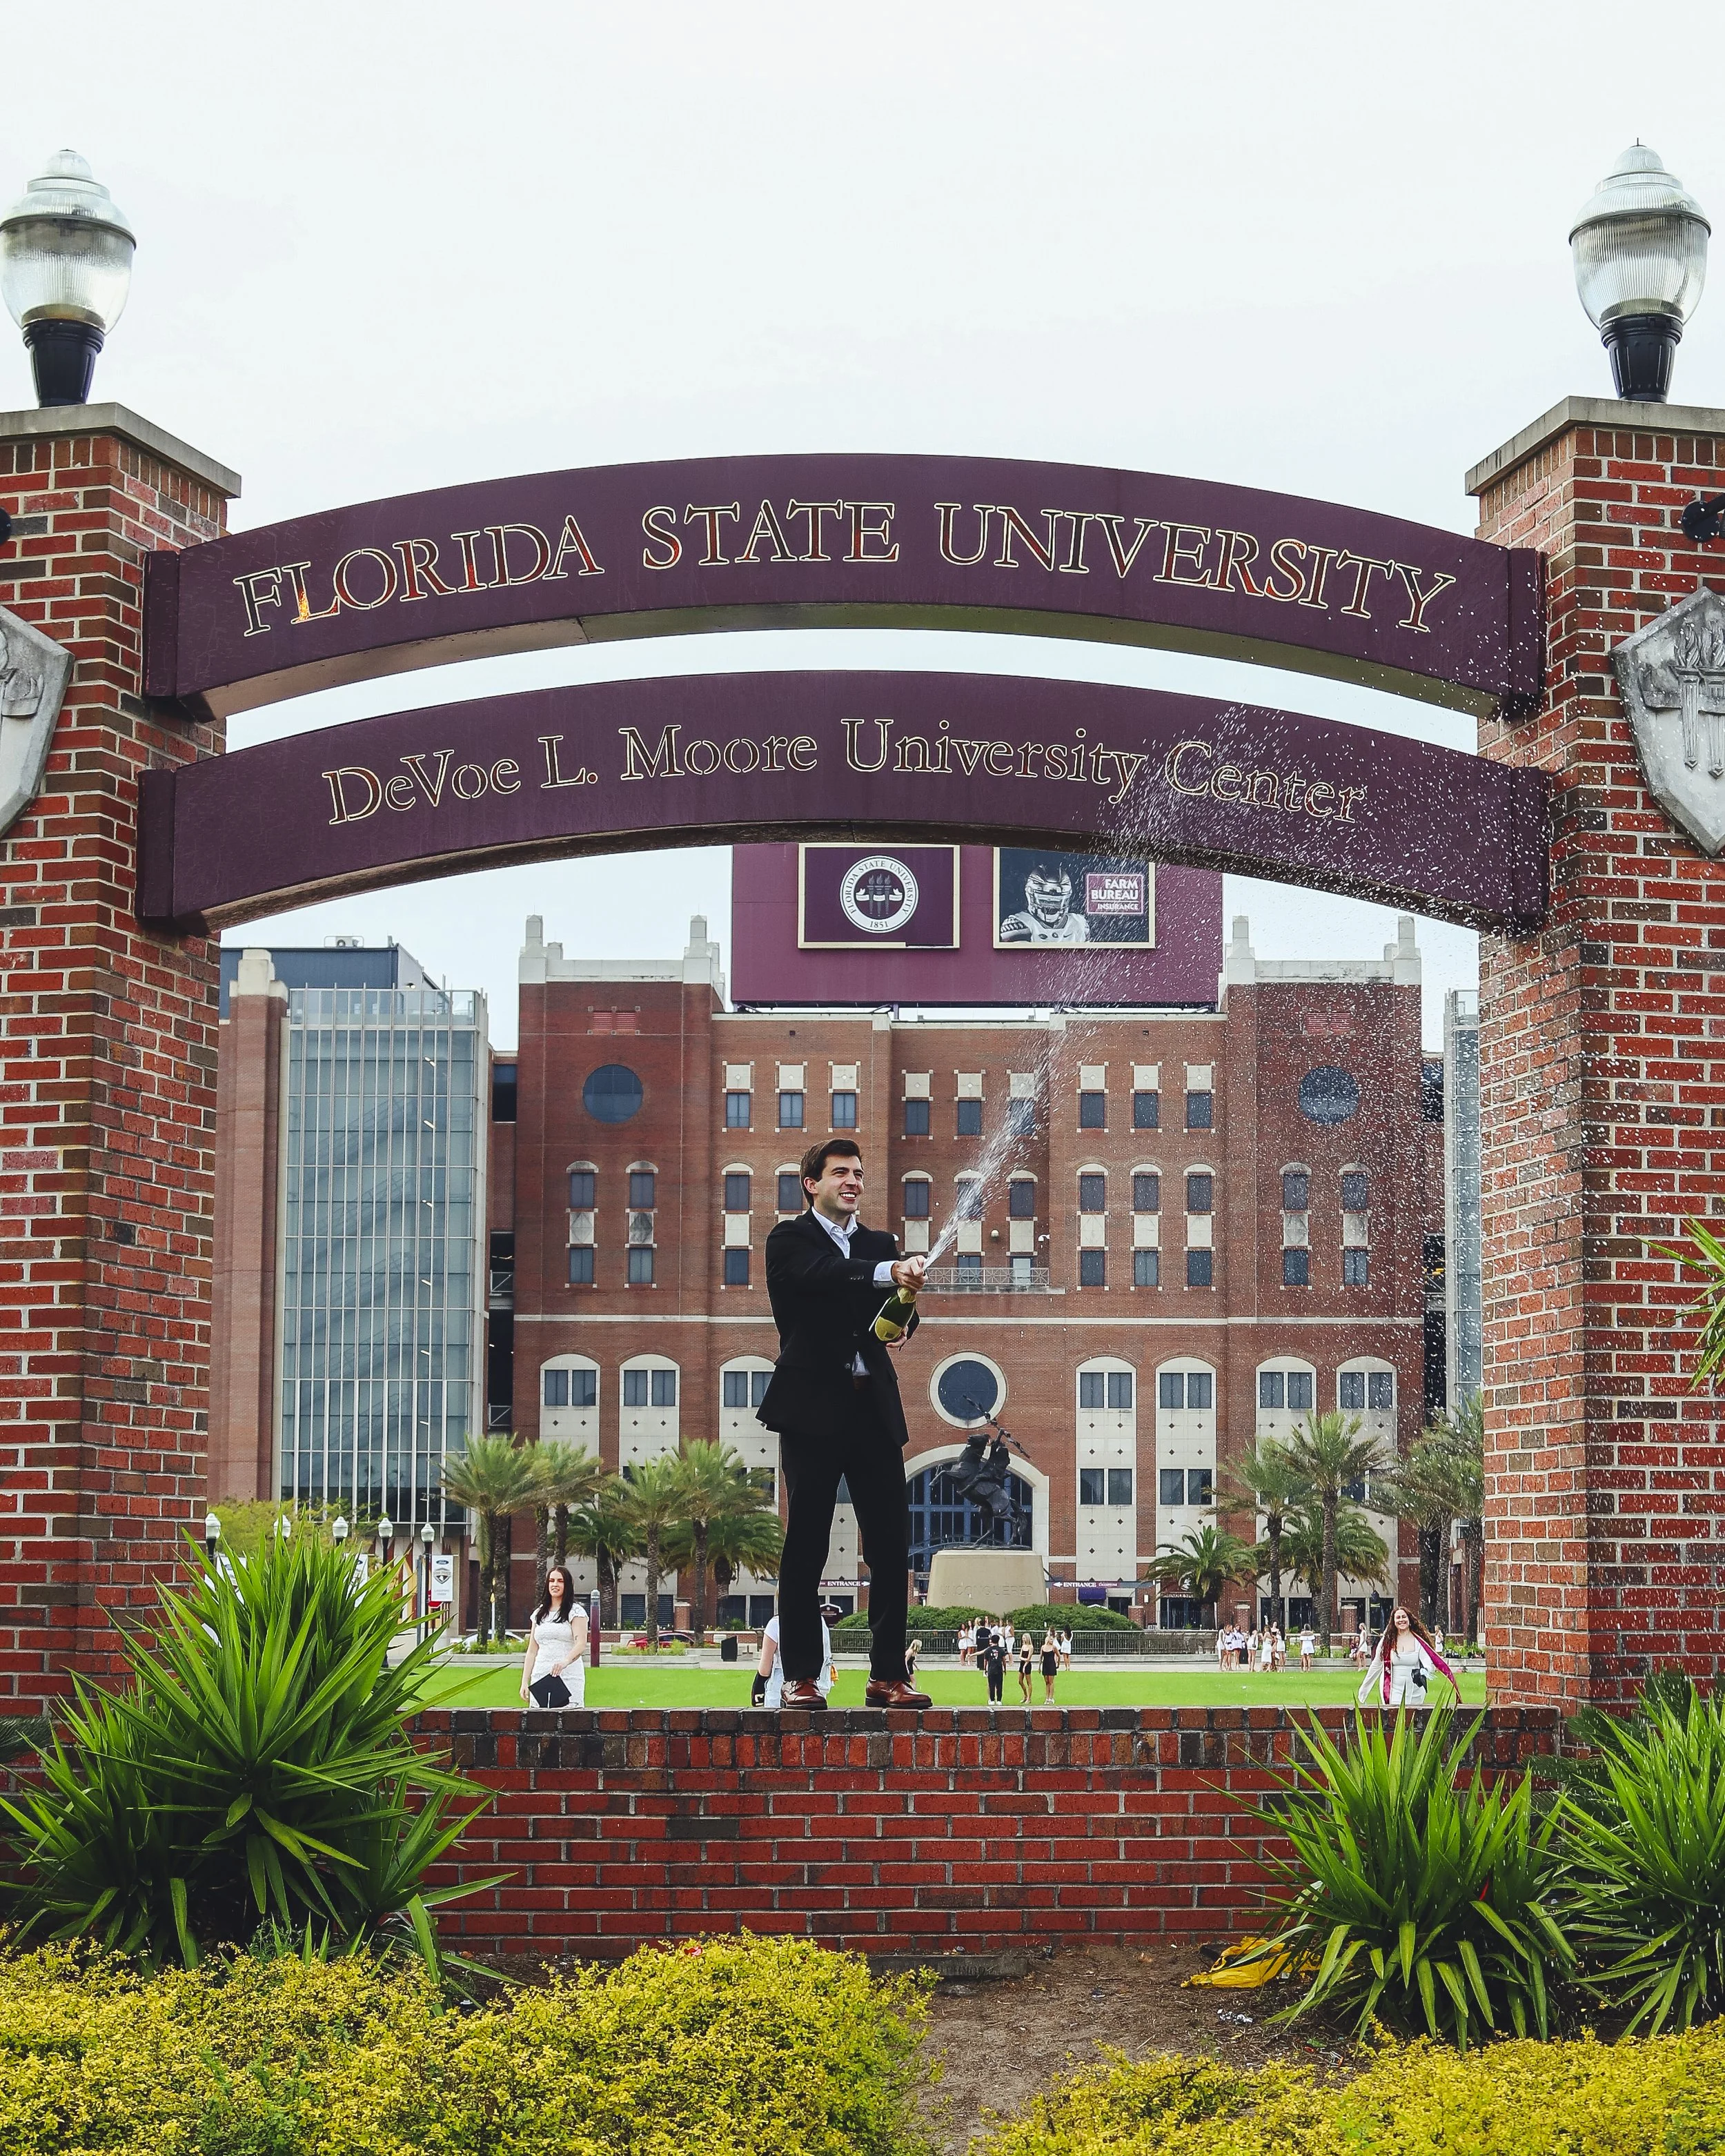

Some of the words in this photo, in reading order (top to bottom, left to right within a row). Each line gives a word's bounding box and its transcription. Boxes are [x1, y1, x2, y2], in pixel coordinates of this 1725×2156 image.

[233, 514, 605, 637] FLORIDA
[642, 499, 900, 570] STATE
[934, 502, 1456, 633] UNIVERSITY
[322, 749, 522, 825] DeVoe
[538, 735, 599, 789] L.
[618, 724, 818, 780] Moore
[840, 718, 1146, 804] University
[1165, 740, 1369, 824] Center
[845, 873, 859, 914] FLORIDA
[858, 860, 886, 873] STATE
[889, 862, 914, 915] UNIVERSITY
[1091, 889, 1138, 900] BUREAU
[1105, 878, 1138, 889] FARM
